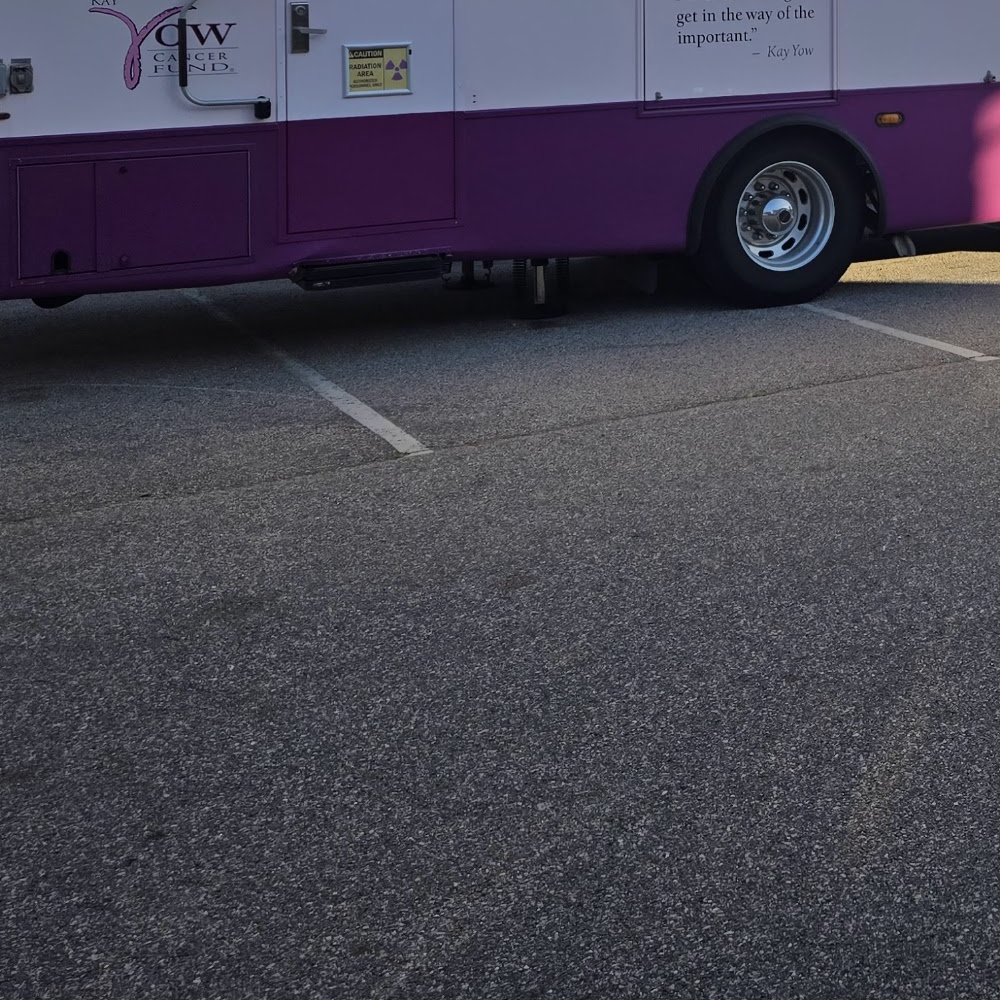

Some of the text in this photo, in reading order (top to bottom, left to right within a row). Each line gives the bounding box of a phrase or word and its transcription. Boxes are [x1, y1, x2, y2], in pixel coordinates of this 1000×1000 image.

[676, 5, 815, 27] get in the way of the
[767, 45, 790, 60] Kay
[791, 44, 815, 56] Yow
